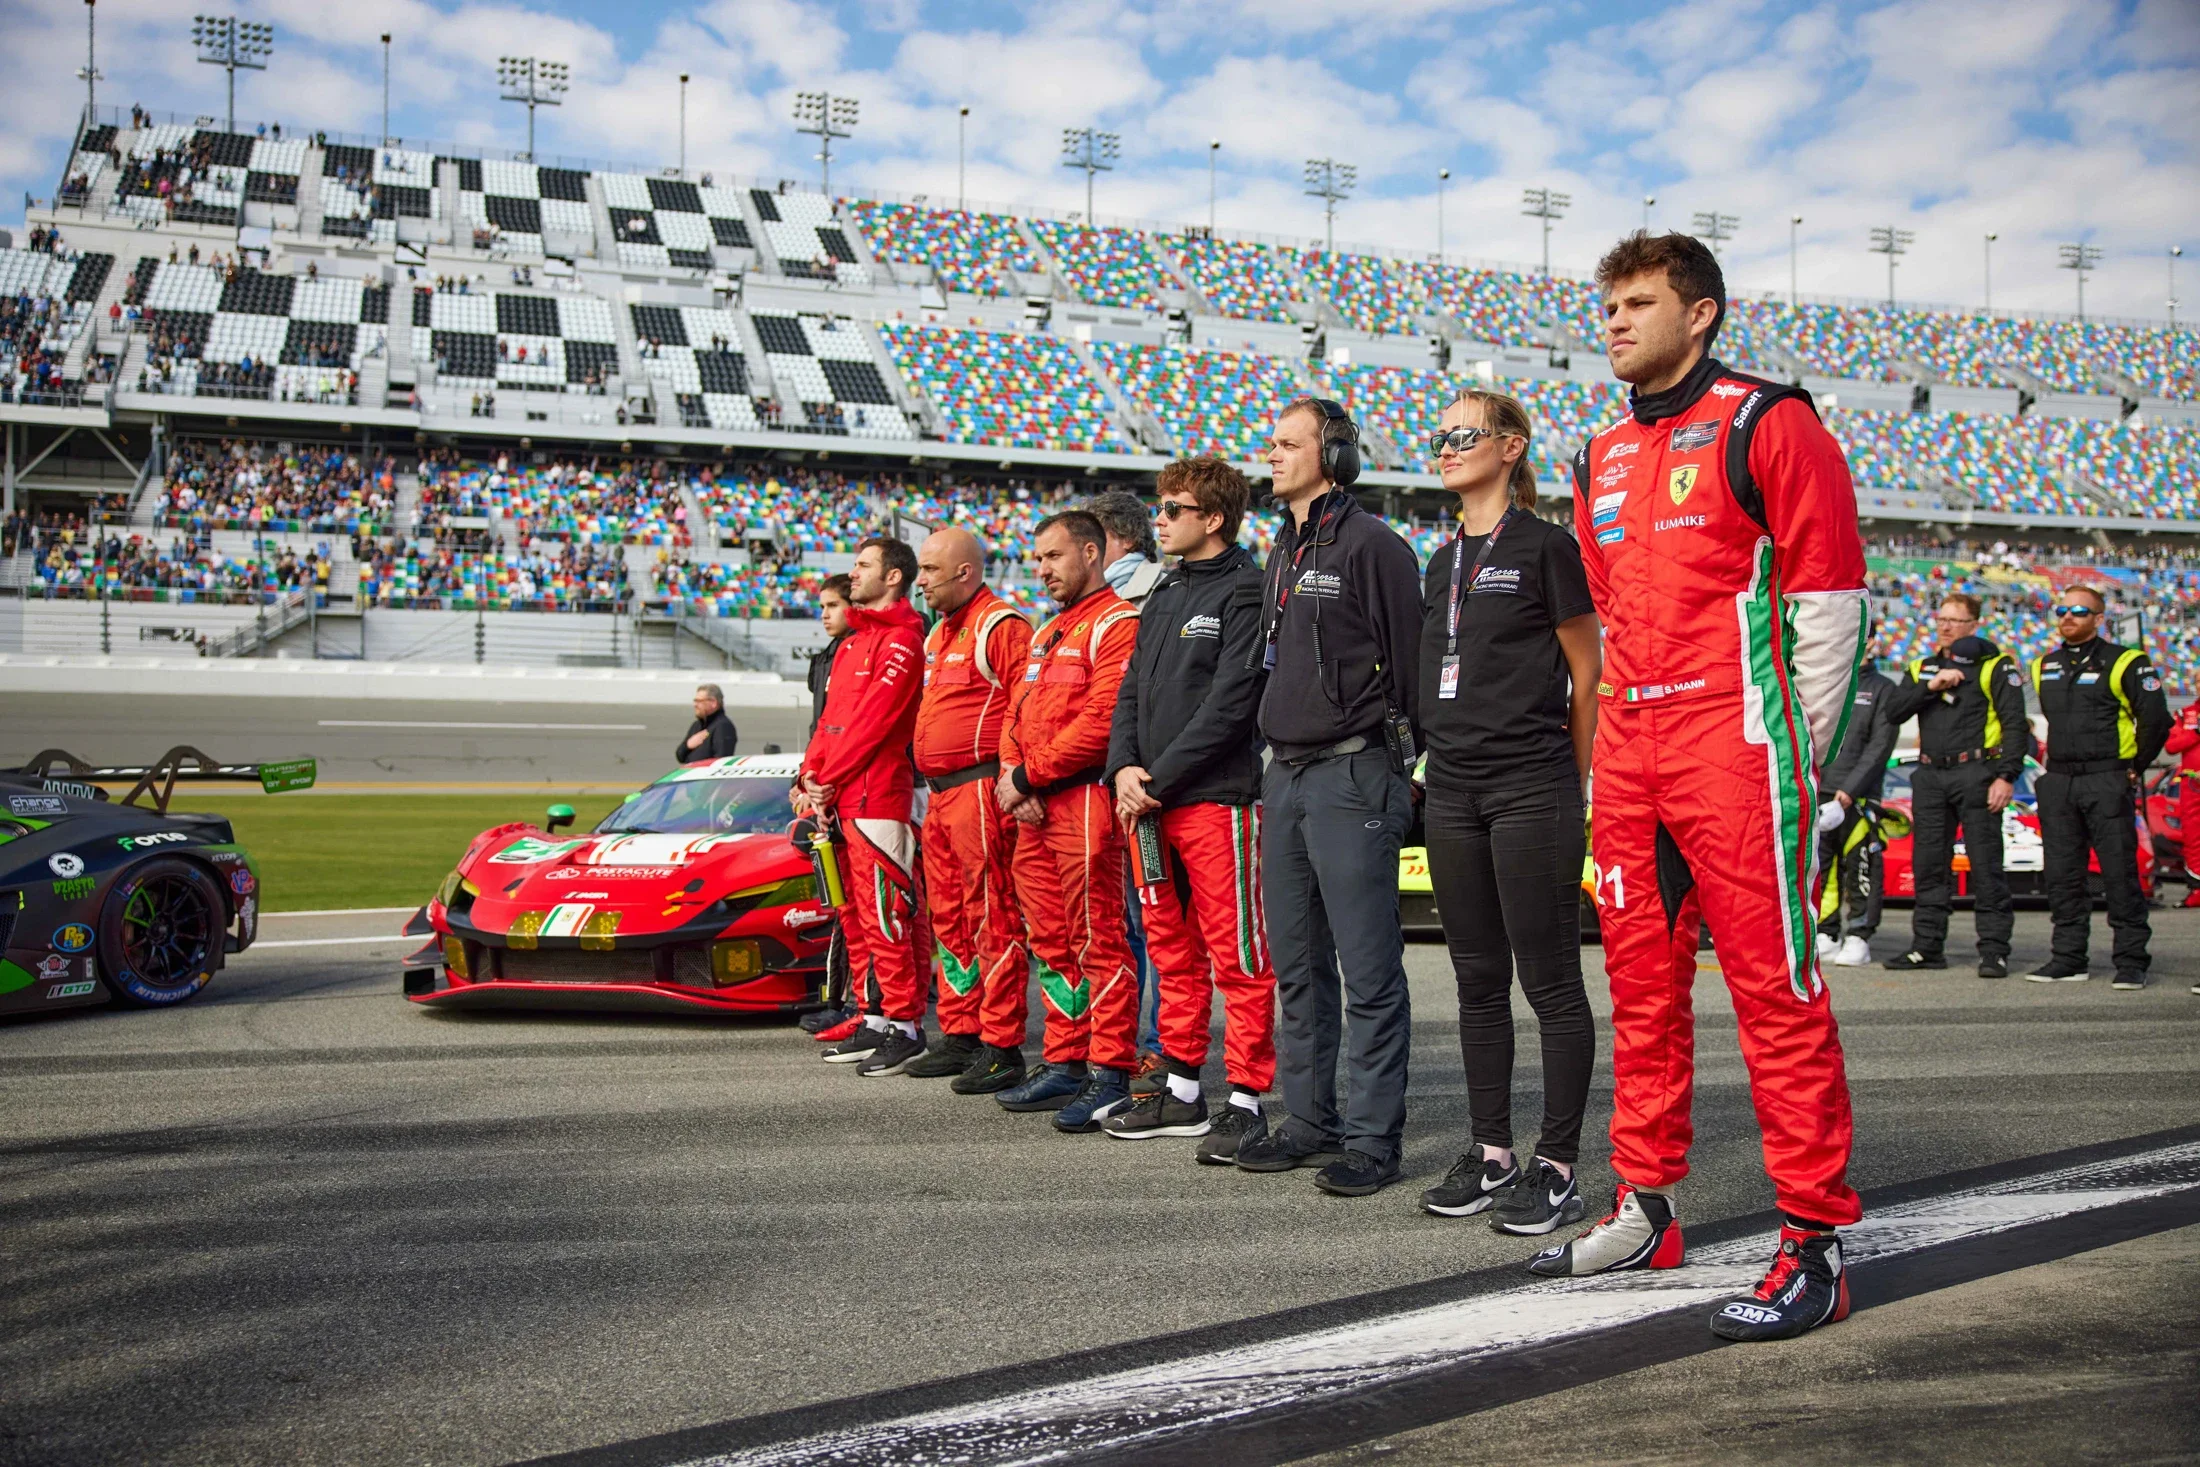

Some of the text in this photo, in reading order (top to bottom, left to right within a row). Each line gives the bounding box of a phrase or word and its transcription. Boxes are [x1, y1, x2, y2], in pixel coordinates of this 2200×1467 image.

[1733, 390, 1763, 429] Sabelt
[1493, 523, 1506, 541] IMSA
[1655, 515, 1706, 532] LUMAIKE
[1449, 583, 1458, 637] WeatherTech
[42, 779, 95, 800] ARROW
[12, 796, 61, 809] change
[585, 867, 674, 876] POSTACUTE
